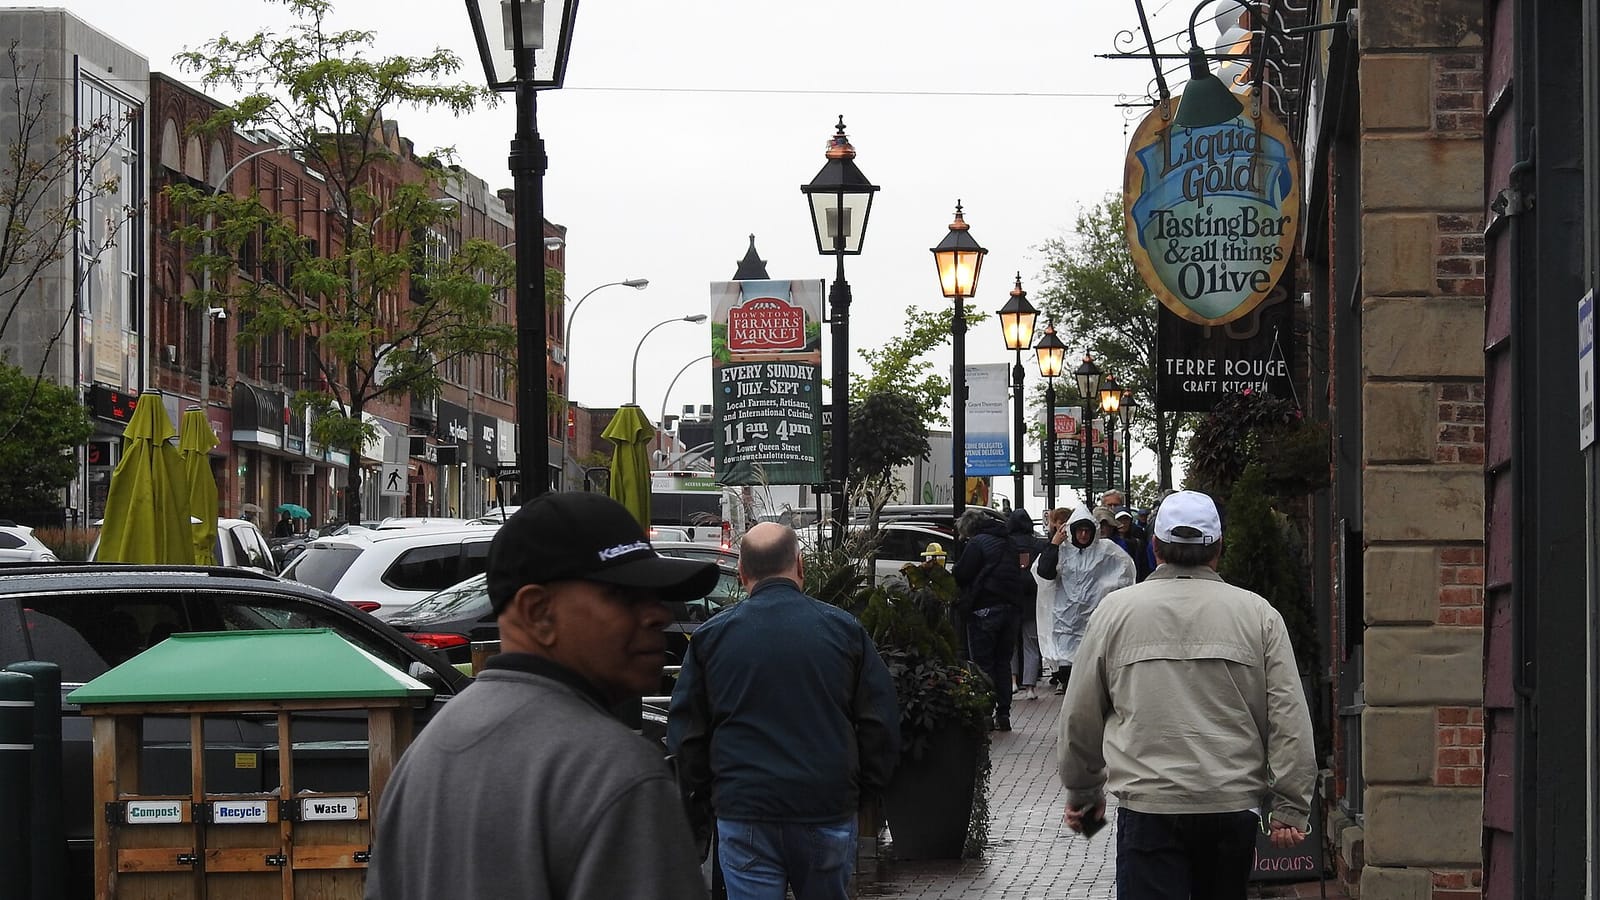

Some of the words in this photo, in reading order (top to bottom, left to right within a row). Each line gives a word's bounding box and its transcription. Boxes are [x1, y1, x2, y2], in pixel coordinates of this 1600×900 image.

[1155, 120, 1265, 179] Liquid
[1182, 158, 1261, 208] Gold
[1149, 204, 1240, 240] Tasting
[1239, 205, 1292, 237] Bar
[1222, 238, 1283, 264] things
[1178, 258, 1271, 299] Olive
[735, 328, 799, 340] MARKET
[721, 364, 762, 382] EVERY
[766, 364, 815, 381] SUNDAY
[1165, 358, 1216, 376] TERRE
[1224, 359, 1286, 376] ROUGE
[1183, 380, 1217, 393] CRAFT
[1222, 381, 1269, 393] KITCHEN
[726, 399, 746, 411] Local
[748, 398, 779, 409] Farmers,
[780, 398, 811, 410] Artisans,
[723, 411, 737, 421] and
[738, 408, 786, 419] International
[788, 408, 814, 420] Cuisine
[724, 421, 769, 446] 11am
[776, 420, 812, 441] 4pm
[736, 444, 757, 454] Lower
[758, 443, 780, 453] Queen
[781, 442, 801, 453] Street
[723, 450, 816, 464] downtowncharlottetown.com
[131, 806, 178, 819] Compost
[219, 806, 261, 819] Recycle
[314, 803, 347, 815] Waste
[1254, 847, 1315, 871] lavours
